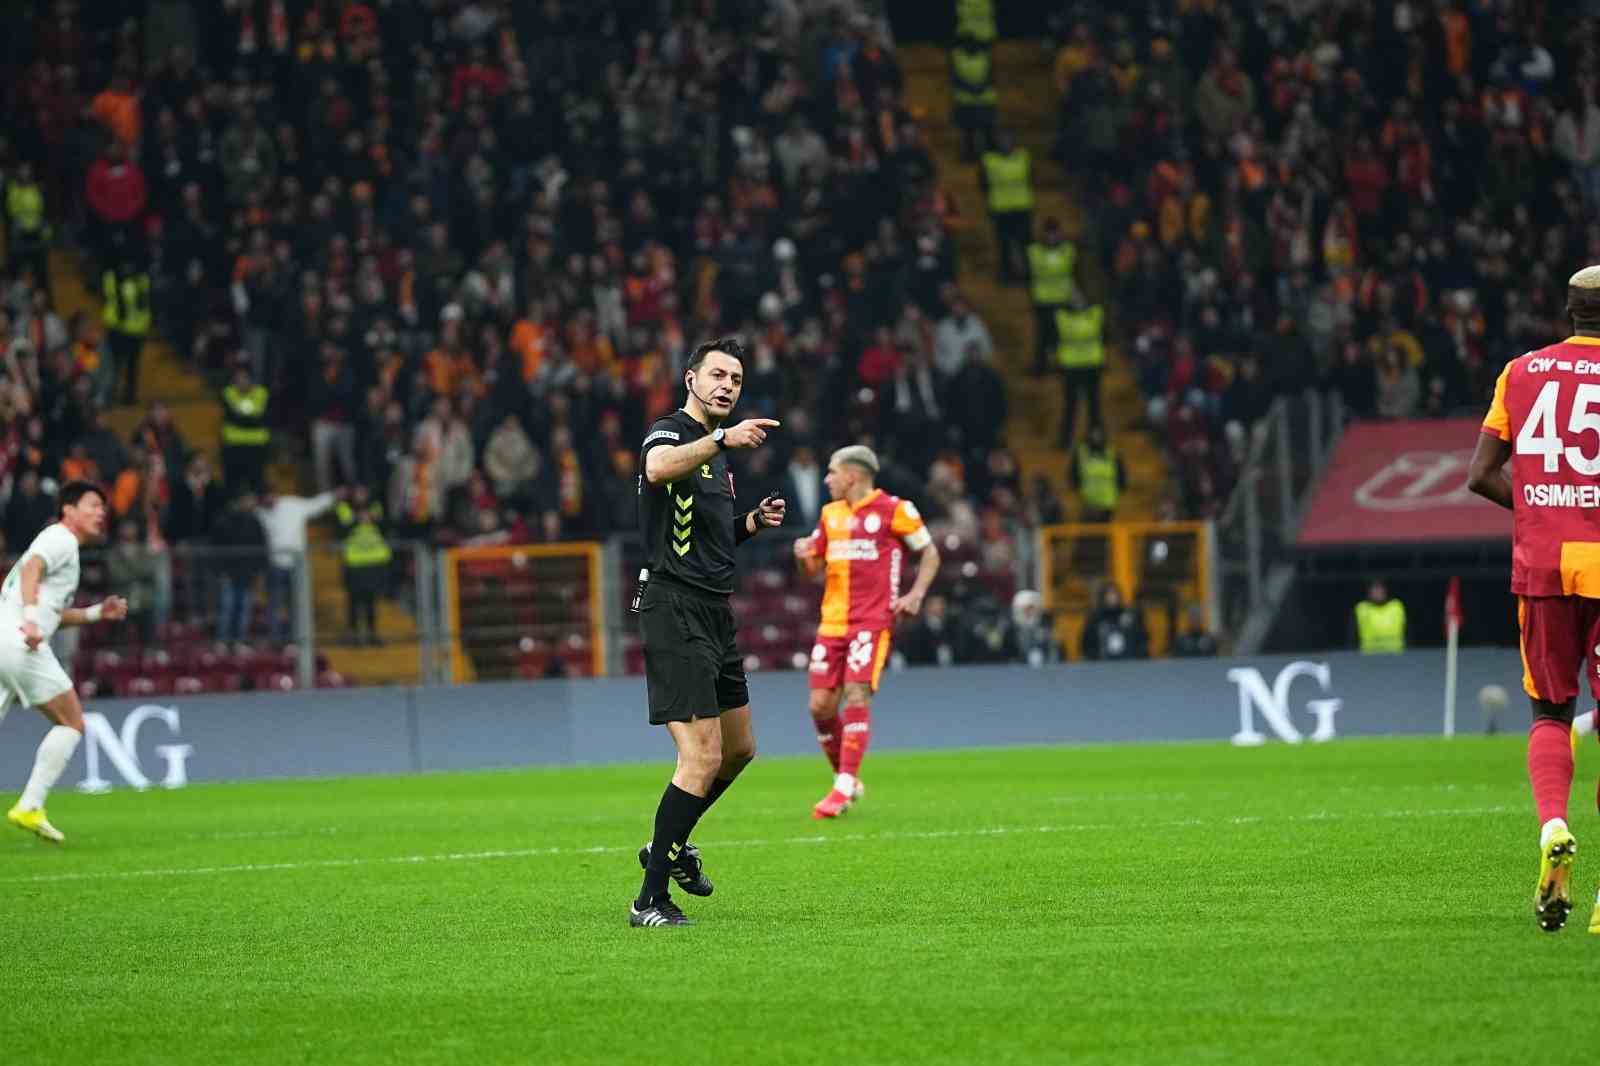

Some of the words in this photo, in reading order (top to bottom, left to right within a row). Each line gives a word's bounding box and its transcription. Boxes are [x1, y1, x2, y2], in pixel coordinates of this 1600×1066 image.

[1528, 358, 1556, 372] CW
[1516, 381, 1600, 476] 45
[1227, 661, 1342, 746] NG
[76, 705, 193, 794] NG
